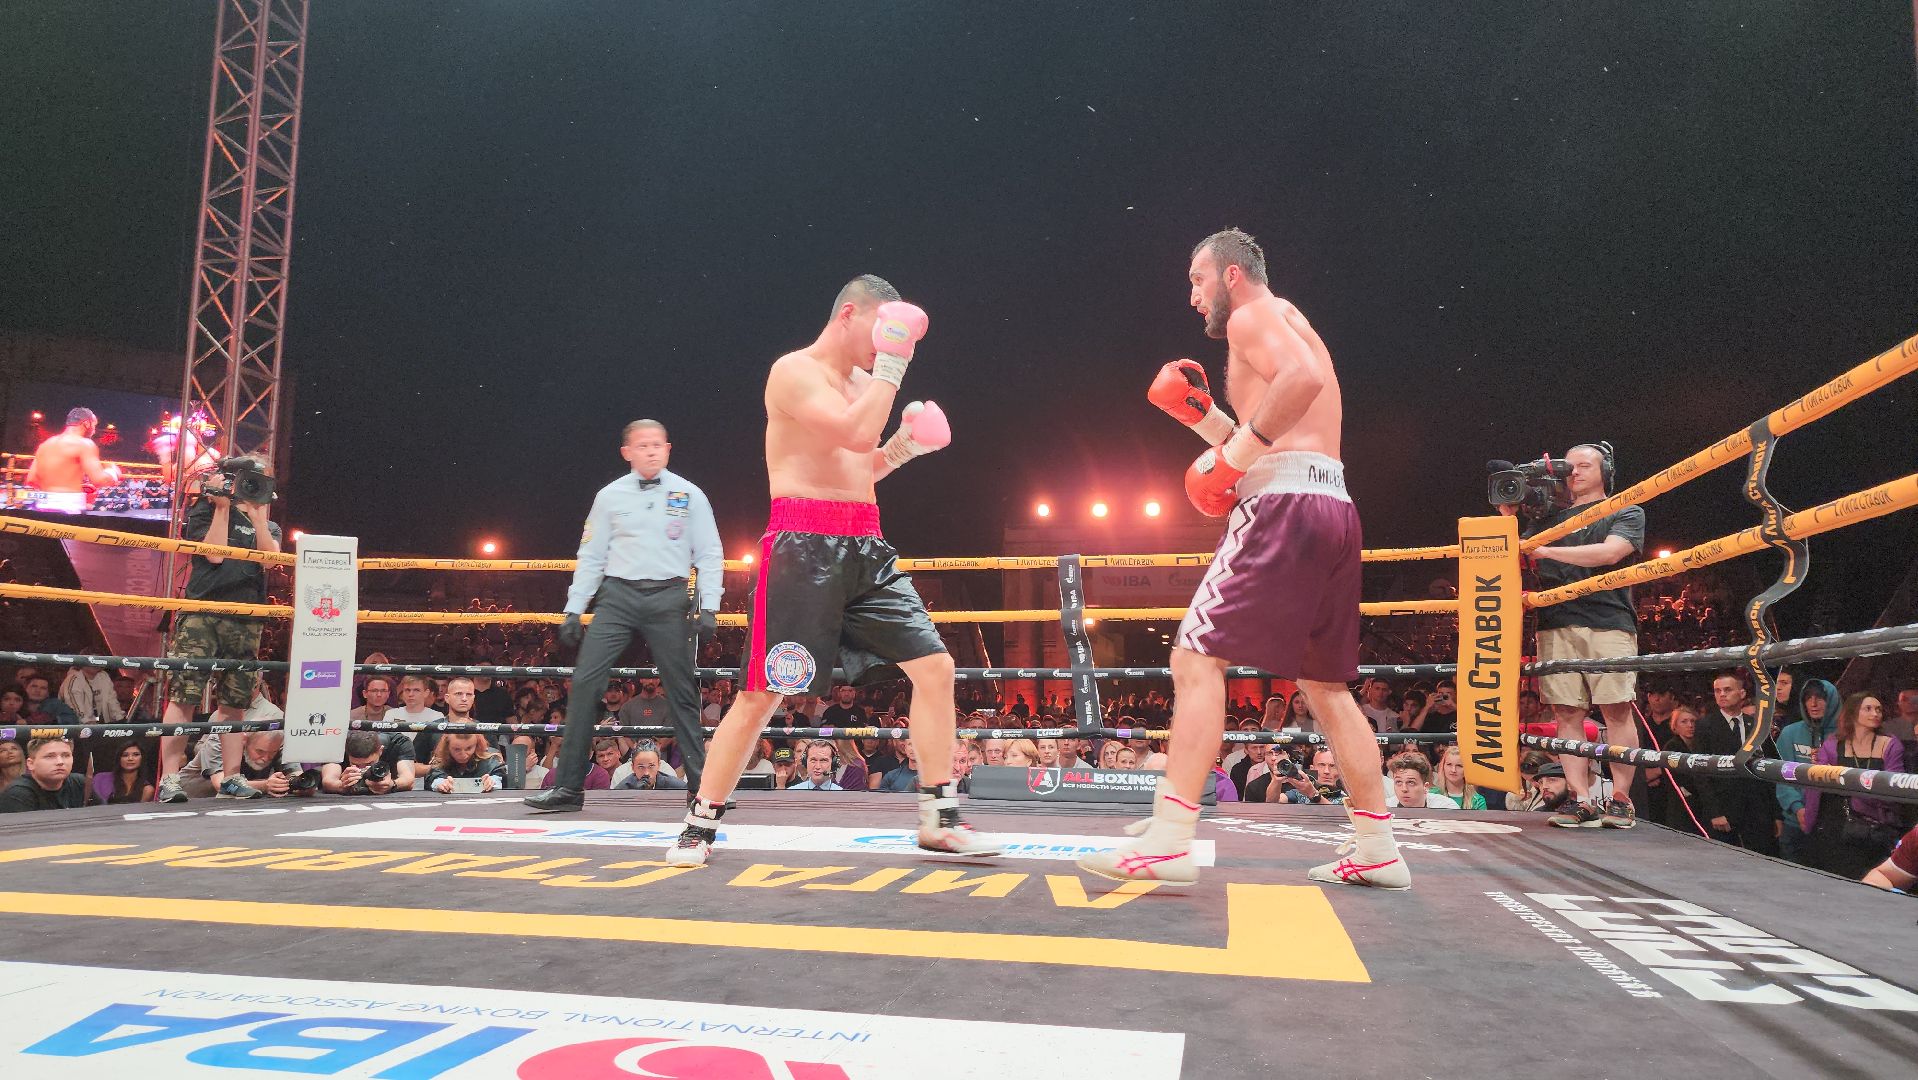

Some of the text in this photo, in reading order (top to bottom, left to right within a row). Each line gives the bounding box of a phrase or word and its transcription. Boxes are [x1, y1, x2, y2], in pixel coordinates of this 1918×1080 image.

[1124, 575, 1151, 587] IBA
[1467, 574, 1502, 690] СТАВОК
[1223, 733, 1257, 742] РОЛЬФ
[1471, 696, 1505, 773] ЛИГА
[50, 845, 1162, 909] ЛИГА СТАВОК
[19, 1002, 539, 1080] IBA
[143, 986, 873, 1045] INTERNATIONAL BOXING ASSOCIATION
